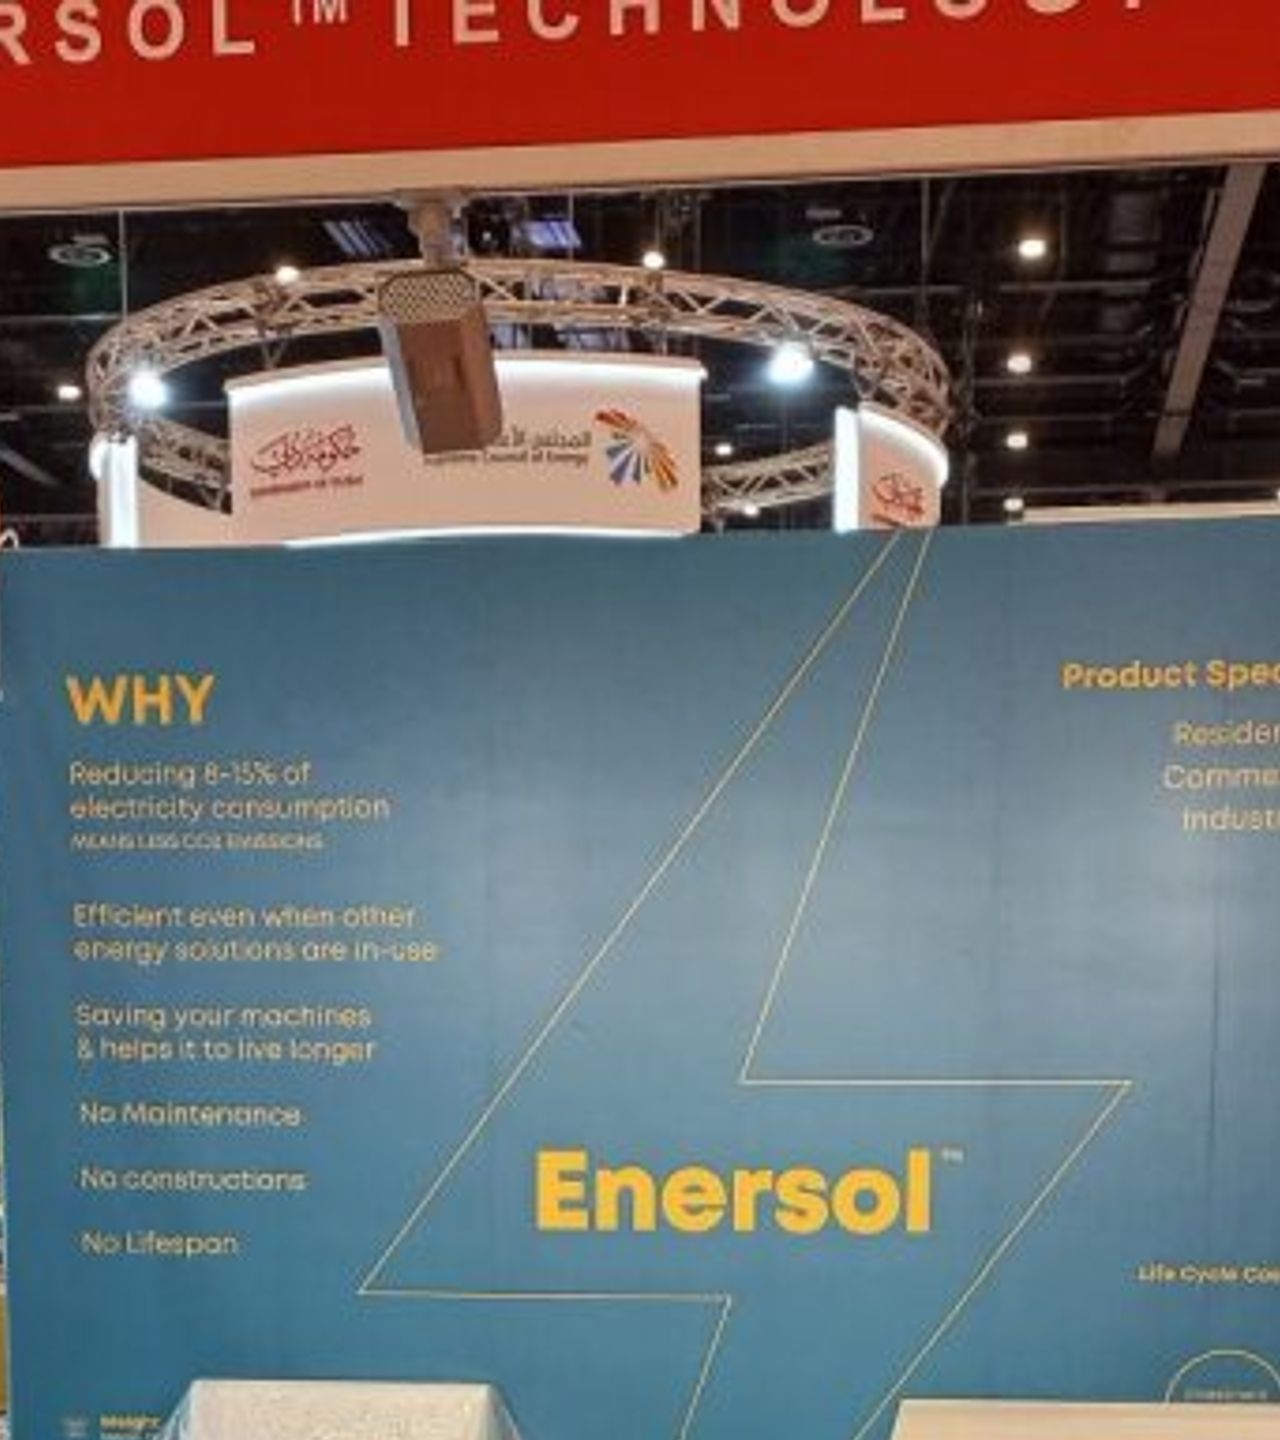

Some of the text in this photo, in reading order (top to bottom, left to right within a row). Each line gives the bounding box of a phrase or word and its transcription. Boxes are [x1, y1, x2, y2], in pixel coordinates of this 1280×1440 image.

[1061, 661, 1197, 690] Product
[66, 675, 214, 725] WHY
[70, 761, 312, 789] Reducing 8-15% of
[70, 795, 391, 823] electricity consumption
[73, 904, 417, 927] Efficient even when other
[74, 939, 439, 965] energy solutions are in-use
[75, 1004, 372, 1031] Saving your machines
[76, 1039, 376, 1065] & helps it to live longer
[80, 1104, 301, 1127] No Maintenance
[81, 1169, 308, 1192] No constructions
[536, 1149, 931, 1235] Enersol
[82, 1231, 239, 1258] No Lifespan
[1138, 1265, 1177, 1282] Life
[1180, 1266, 1239, 1284] Cycle
